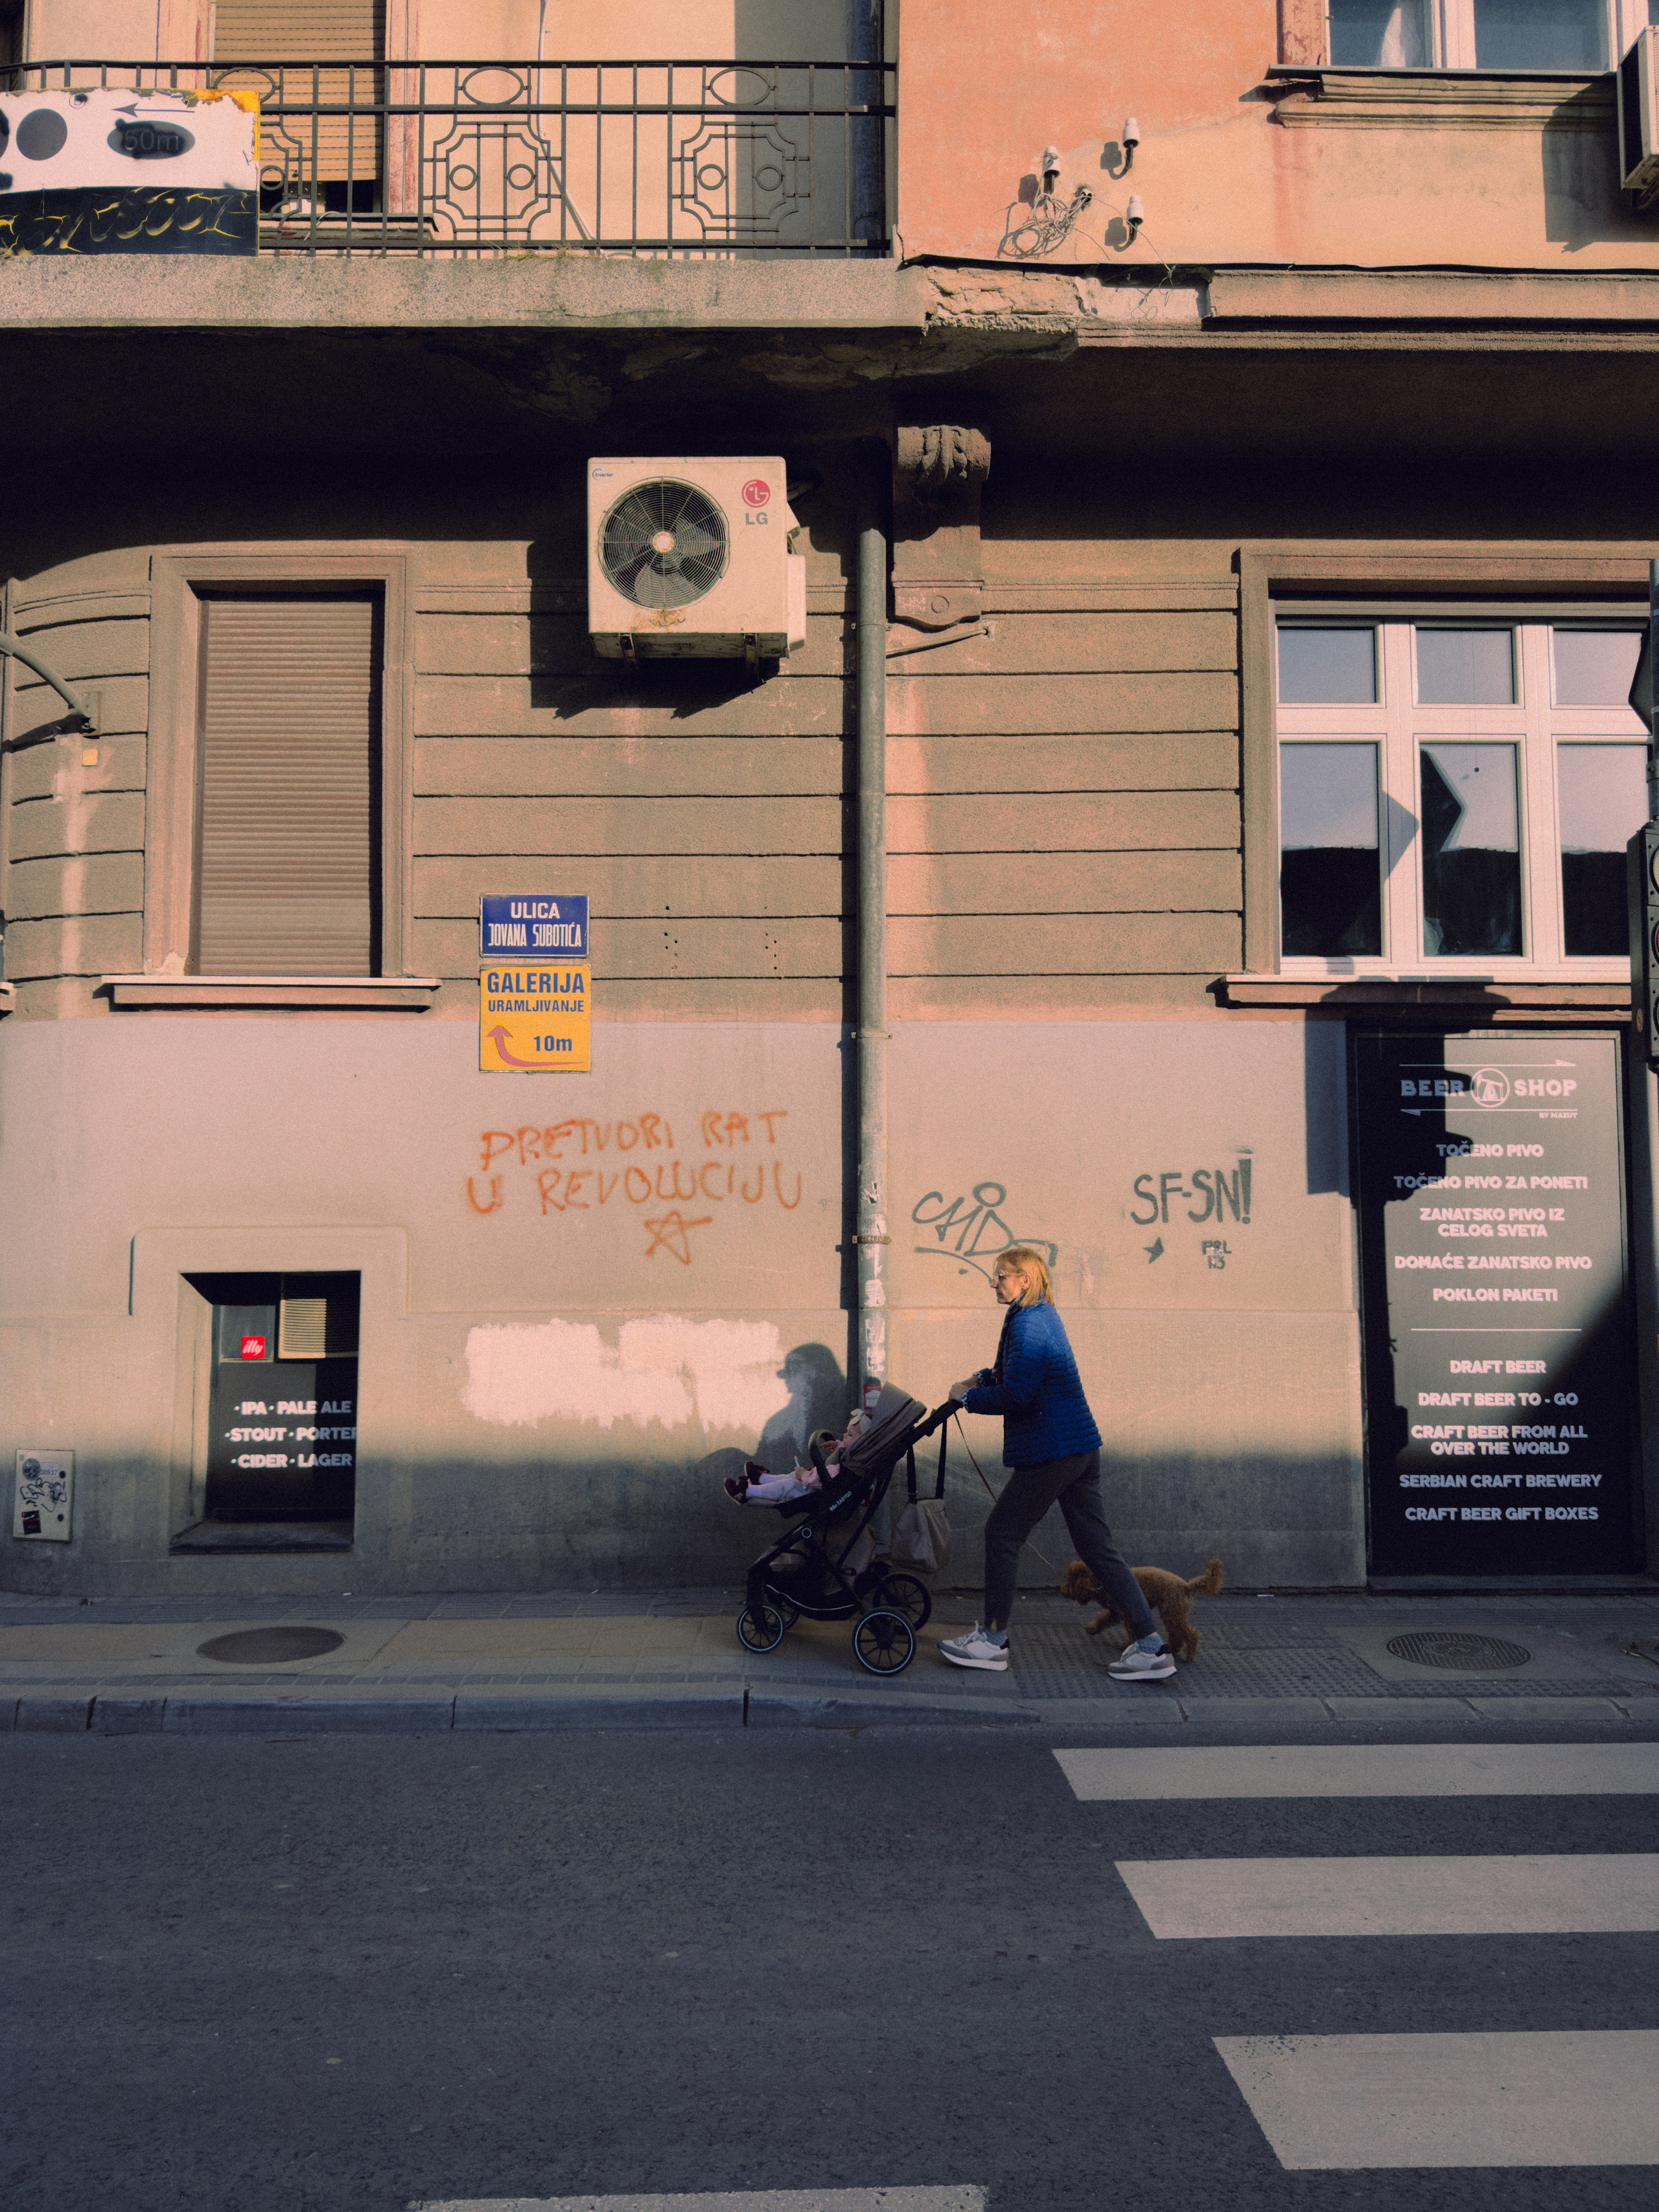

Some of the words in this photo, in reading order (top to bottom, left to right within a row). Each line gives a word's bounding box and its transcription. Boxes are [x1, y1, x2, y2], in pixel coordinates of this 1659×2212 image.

[745, 512, 768, 525] LG
[511, 902, 561, 919] ULICA
[488, 923, 527, 947] JOVANA
[532, 922, 582, 947] SUBOTIĆA
[487, 972, 585, 994] GALERIJA
[488, 999, 585, 1012] URAMLJIVANJE
[533, 1035, 573, 1052] 10m
[1400, 1080, 1465, 1097] BEER
[1514, 1079, 1577, 1097] SHOP
[701, 1111, 787, 1147] RAT
[1436, 1141, 1503, 1157] TOČENO
[1507, 1145, 1544, 1157] PIVO
[1393, 1173, 1461, 1189] TOČENO
[1465, 1176, 1502, 1189] PIVO
[1505, 1176, 1527, 1189] ZA
[1531, 1176, 1588, 1189] PONETI
[467, 1174, 503, 1213] U
[1420, 1208, 1505, 1220] ZANATSKO
[1509, 1208, 1546, 1220] PIVO
[1549, 1208, 1565, 1220] IZ
[1438, 1224, 1493, 1237] CELOG
[1497, 1224, 1548, 1237] SVETA
[1395, 1253, 1465, 1268] DOMAĆE
[1467, 1256, 1553, 1268] ZANATSKO
[1555, 1256, 1592, 1268] PIVO
[1433, 1288, 1500, 1301] POKLON
[1503, 1288, 1558, 1301] PAKETI
[242, 1340, 263, 1356] illy
[1450, 1360, 1503, 1373] DRAFT
[1505, 1360, 1546, 1373] BEER
[1419, 1393, 1472, 1406] DRAFT
[1474, 1393, 1515, 1406] BEER
[1518, 1393, 1541, 1406] TO
[1553, 1393, 1579, 1406] GO
[242, 1402, 267, 1415] IPA
[277, 1401, 317, 1415] PALE
[321, 1401, 352, 1414] ALE
[230, 1428, 287, 1442] STOUT
[1411, 1426, 1465, 1438] CRAFT
[1468, 1426, 1508, 1438] BEER
[1511, 1426, 1555, 1438] FROM
[1560, 1426, 1588, 1438] ALL
[1431, 1442, 1475, 1455] OVER
[1478, 1442, 1510, 1455] THE
[1514, 1442, 1569, 1454] WORLD
[238, 1454, 288, 1468] CIDER
[297, 1454, 352, 1467] LAGER
[1399, 1474, 1467, 1487] SERBIAN
[1470, 1474, 1522, 1487] CRAFT
[1526, 1474, 1602, 1487] BREWERY
[837, 1491, 852, 1505] EASYGO
[1405, 1508, 1457, 1520] CRAFT
[1461, 1508, 1502, 1520] BEER
[1505, 1508, 1542, 1520] GIFT
[1545, 1507, 1599, 1520] BOXES
